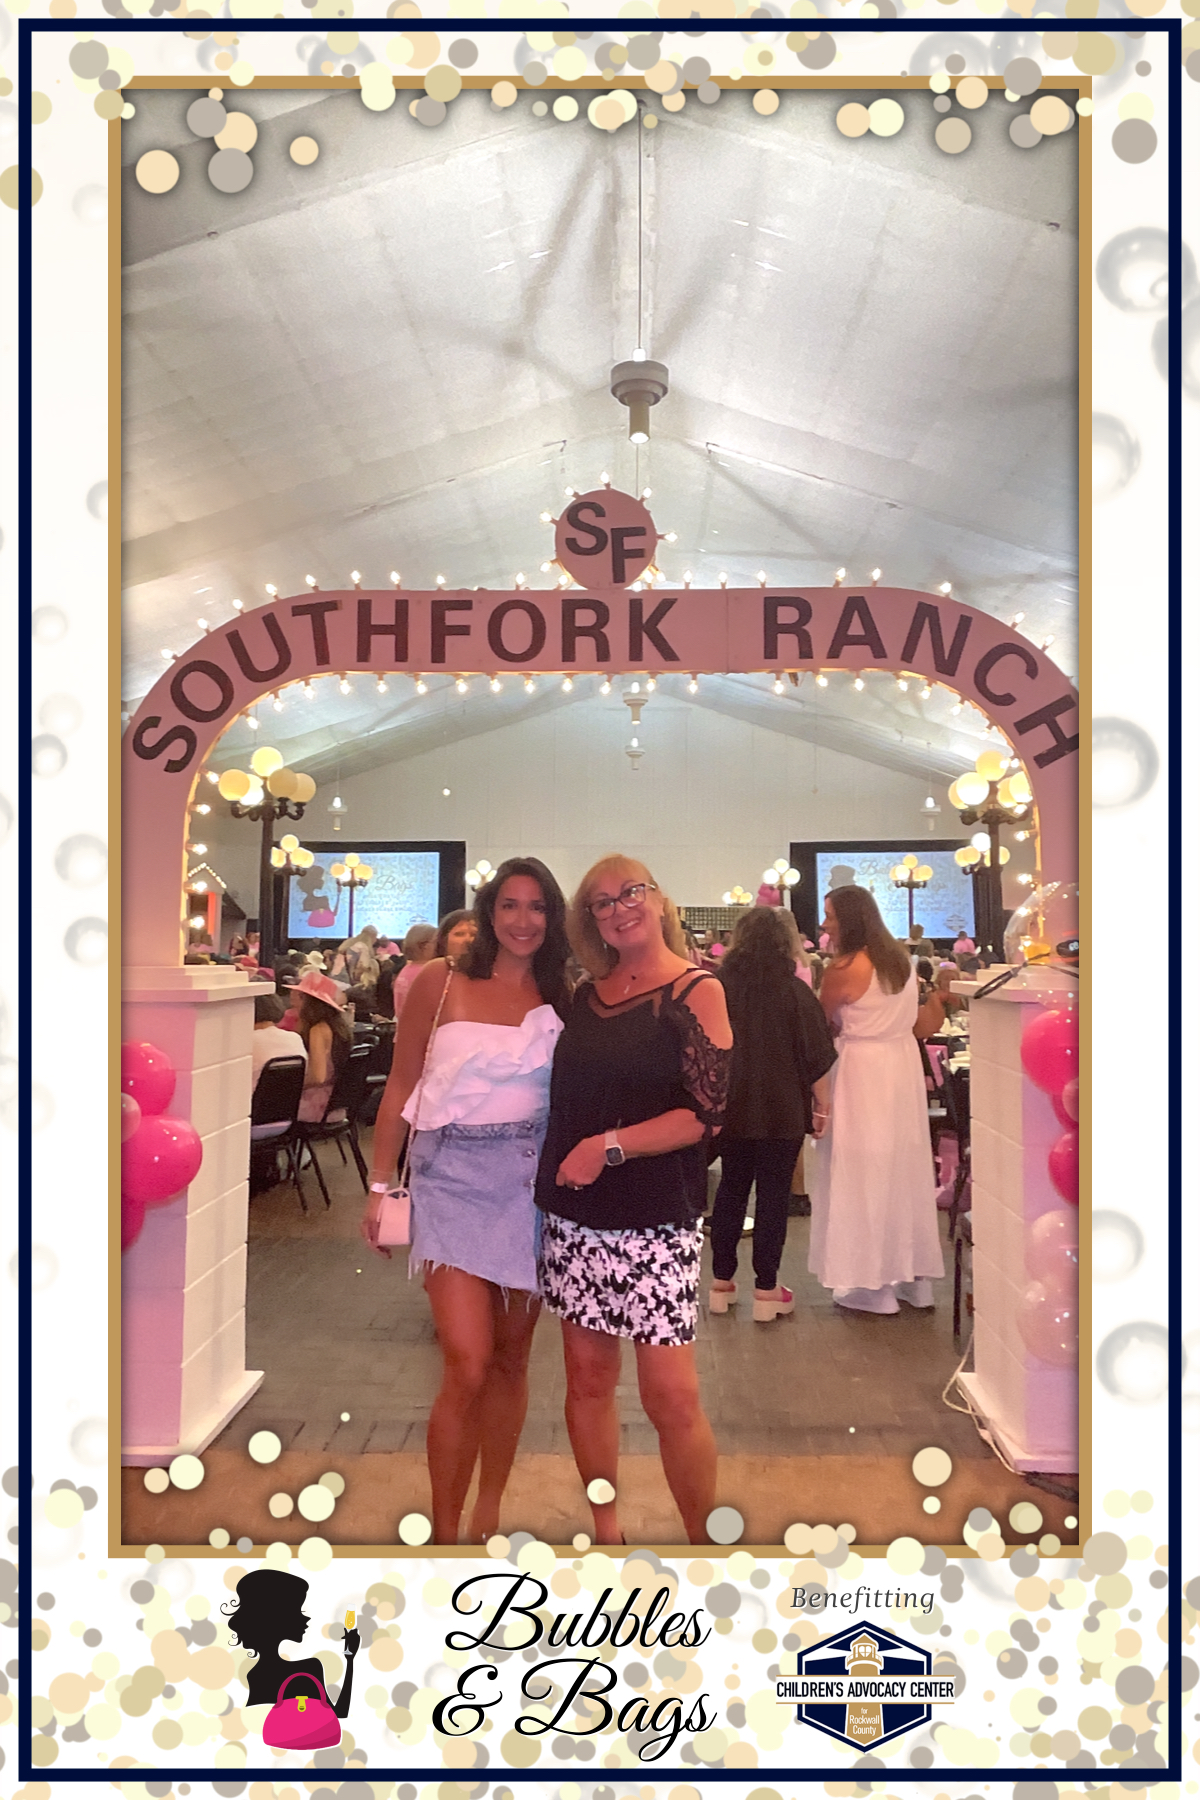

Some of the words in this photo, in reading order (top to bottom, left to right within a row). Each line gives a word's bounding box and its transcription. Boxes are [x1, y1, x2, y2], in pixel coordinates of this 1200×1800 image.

[564, 500, 646, 584] SF
[133, 597, 680, 774] SOUTHFORK
[763, 594, 1079, 770] RANCH
